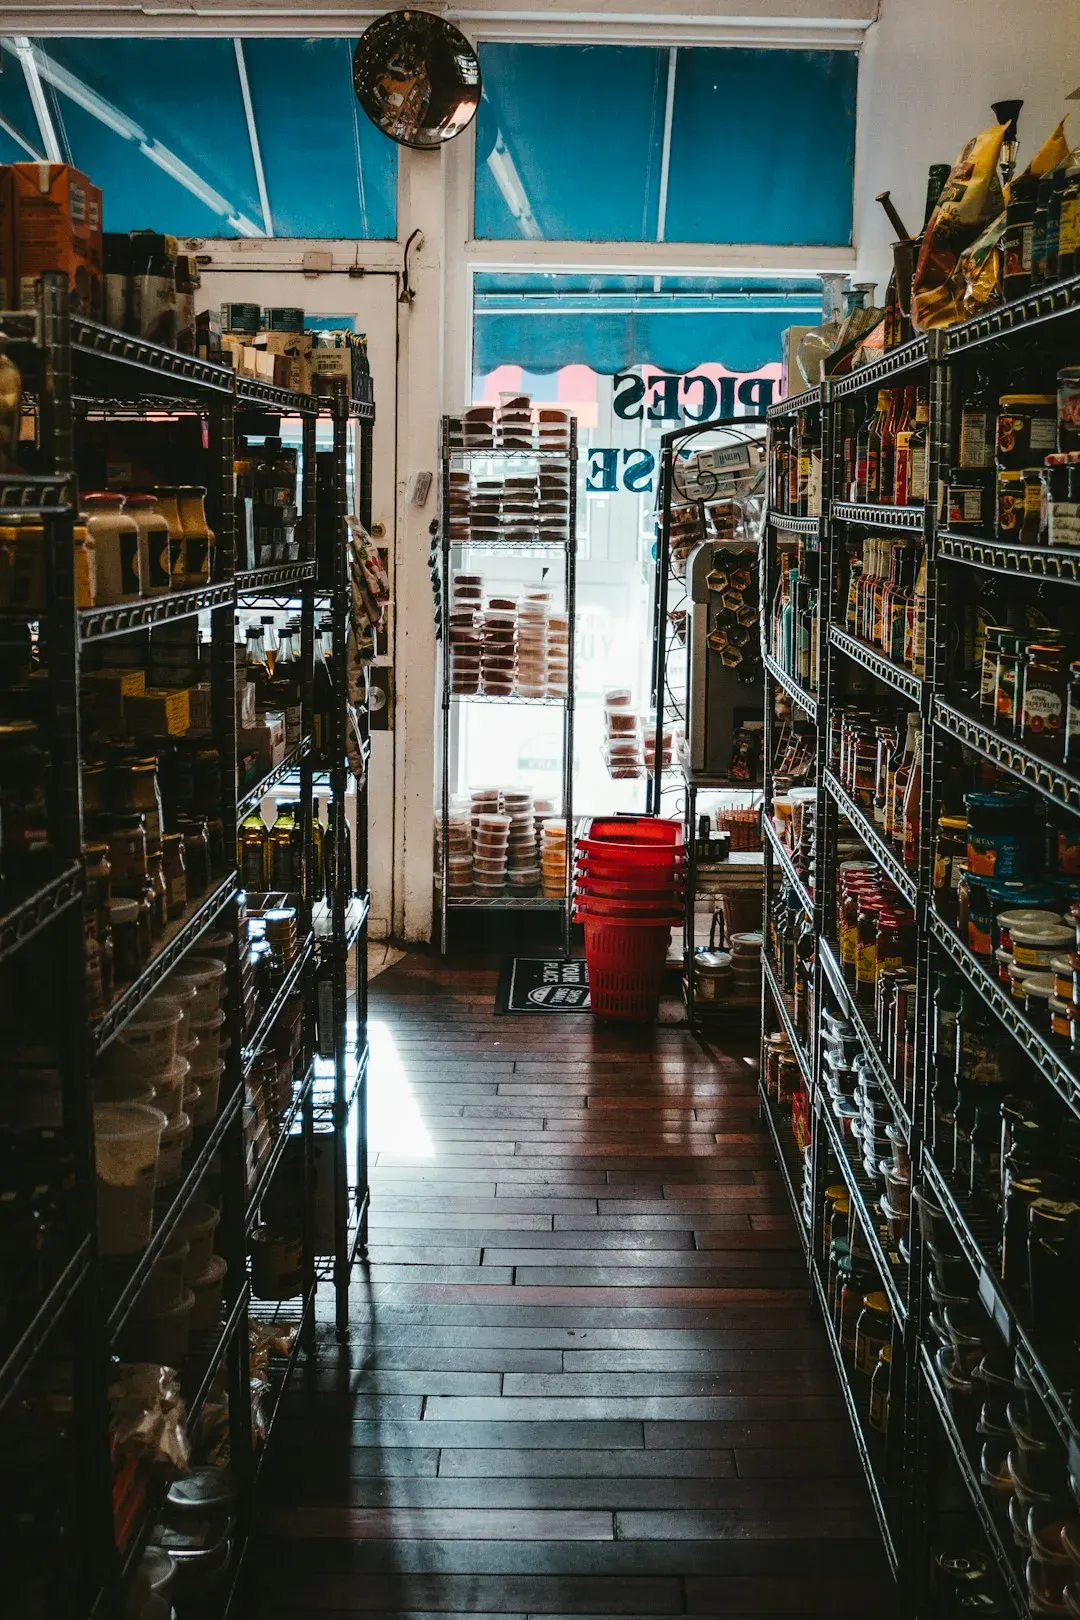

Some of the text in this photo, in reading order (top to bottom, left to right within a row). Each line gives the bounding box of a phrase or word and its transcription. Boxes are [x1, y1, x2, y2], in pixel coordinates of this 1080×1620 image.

[1025, 700, 1060, 709] RAPEFRUIT
[543, 962, 558, 982] PLACE
[562, 963, 580, 982] YOUR
[549, 987, 570, 1003] SMALL
[565, 989, 583, 1003] SHOP
